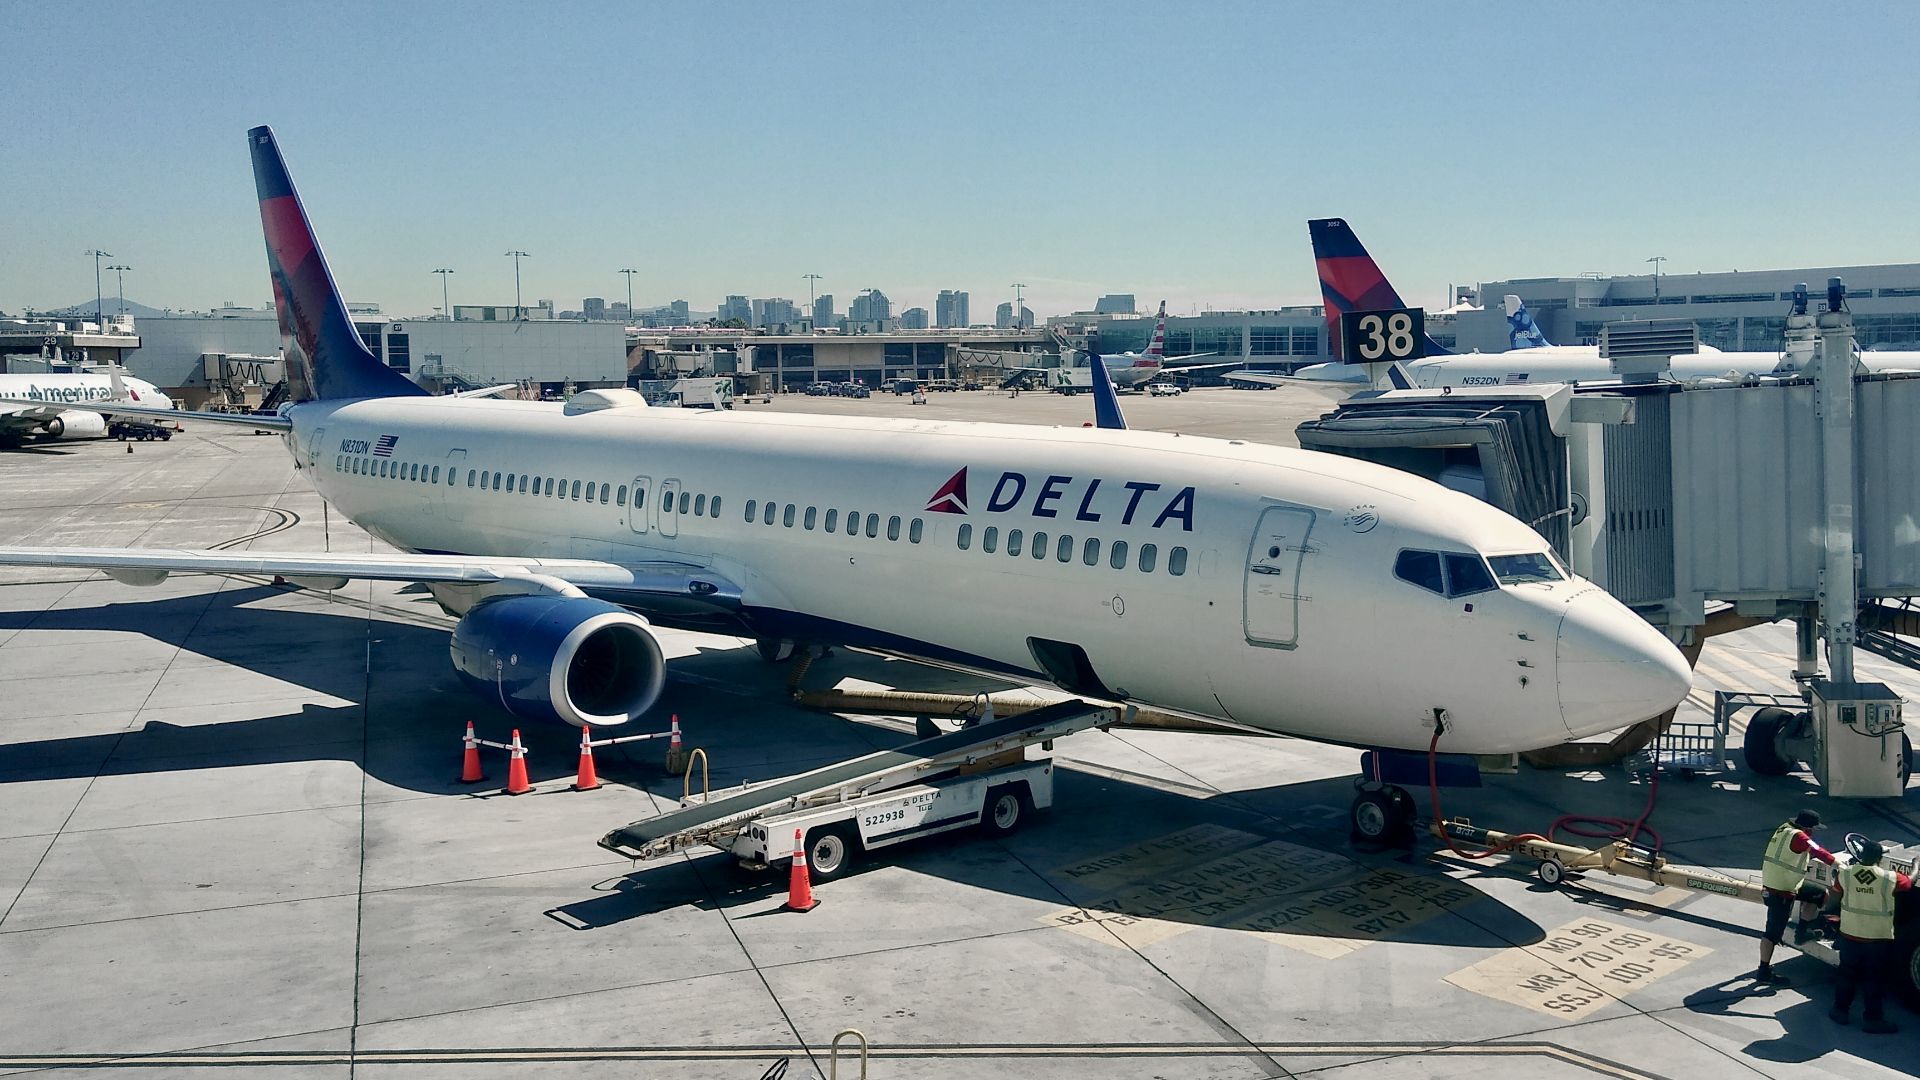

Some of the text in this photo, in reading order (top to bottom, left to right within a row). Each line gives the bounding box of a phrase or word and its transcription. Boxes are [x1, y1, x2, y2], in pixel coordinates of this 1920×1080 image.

[44, 336, 57, 345] 29
[1359, 313, 1414, 359] 38
[1514, 330, 1537, 340] jetBlue
[1461, 376, 1501, 385] N352DN
[29, 383, 120, 402] America
[339, 438, 372, 455] N831DN
[986, 471, 1196, 531] DELTA
[912, 791, 942, 805] DELTA
[865, 810, 905, 827] 522938
[1455, 826, 1476, 837] B737
[1702, 883, 1738, 895] EQUIPPED
[1855, 887, 1874, 895] unifi
[1537, 923, 1613, 955] MD 90
[1516, 967, 1578, 993] MRJ
[1543, 985, 1604, 1013] SSJ
